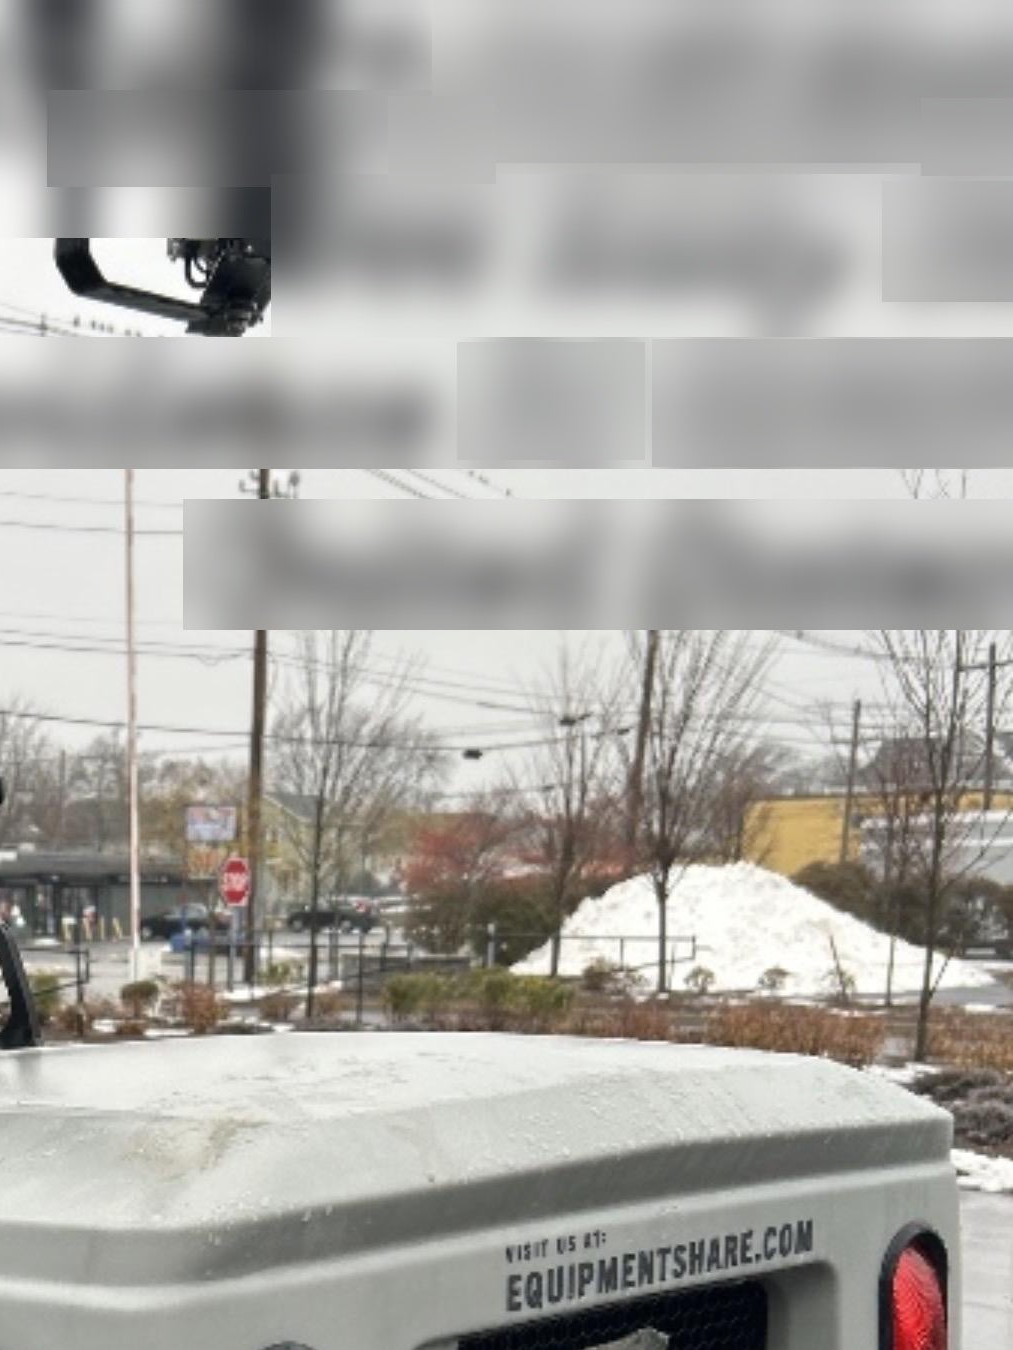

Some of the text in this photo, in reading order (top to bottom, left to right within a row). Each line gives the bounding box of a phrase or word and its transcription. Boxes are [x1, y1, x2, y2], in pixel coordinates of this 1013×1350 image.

[506, 1239, 549, 1263] VISIT
[556, 1235, 576, 1254] US
[506, 1220, 814, 1312] EQUIPMENTSHARE.COM
